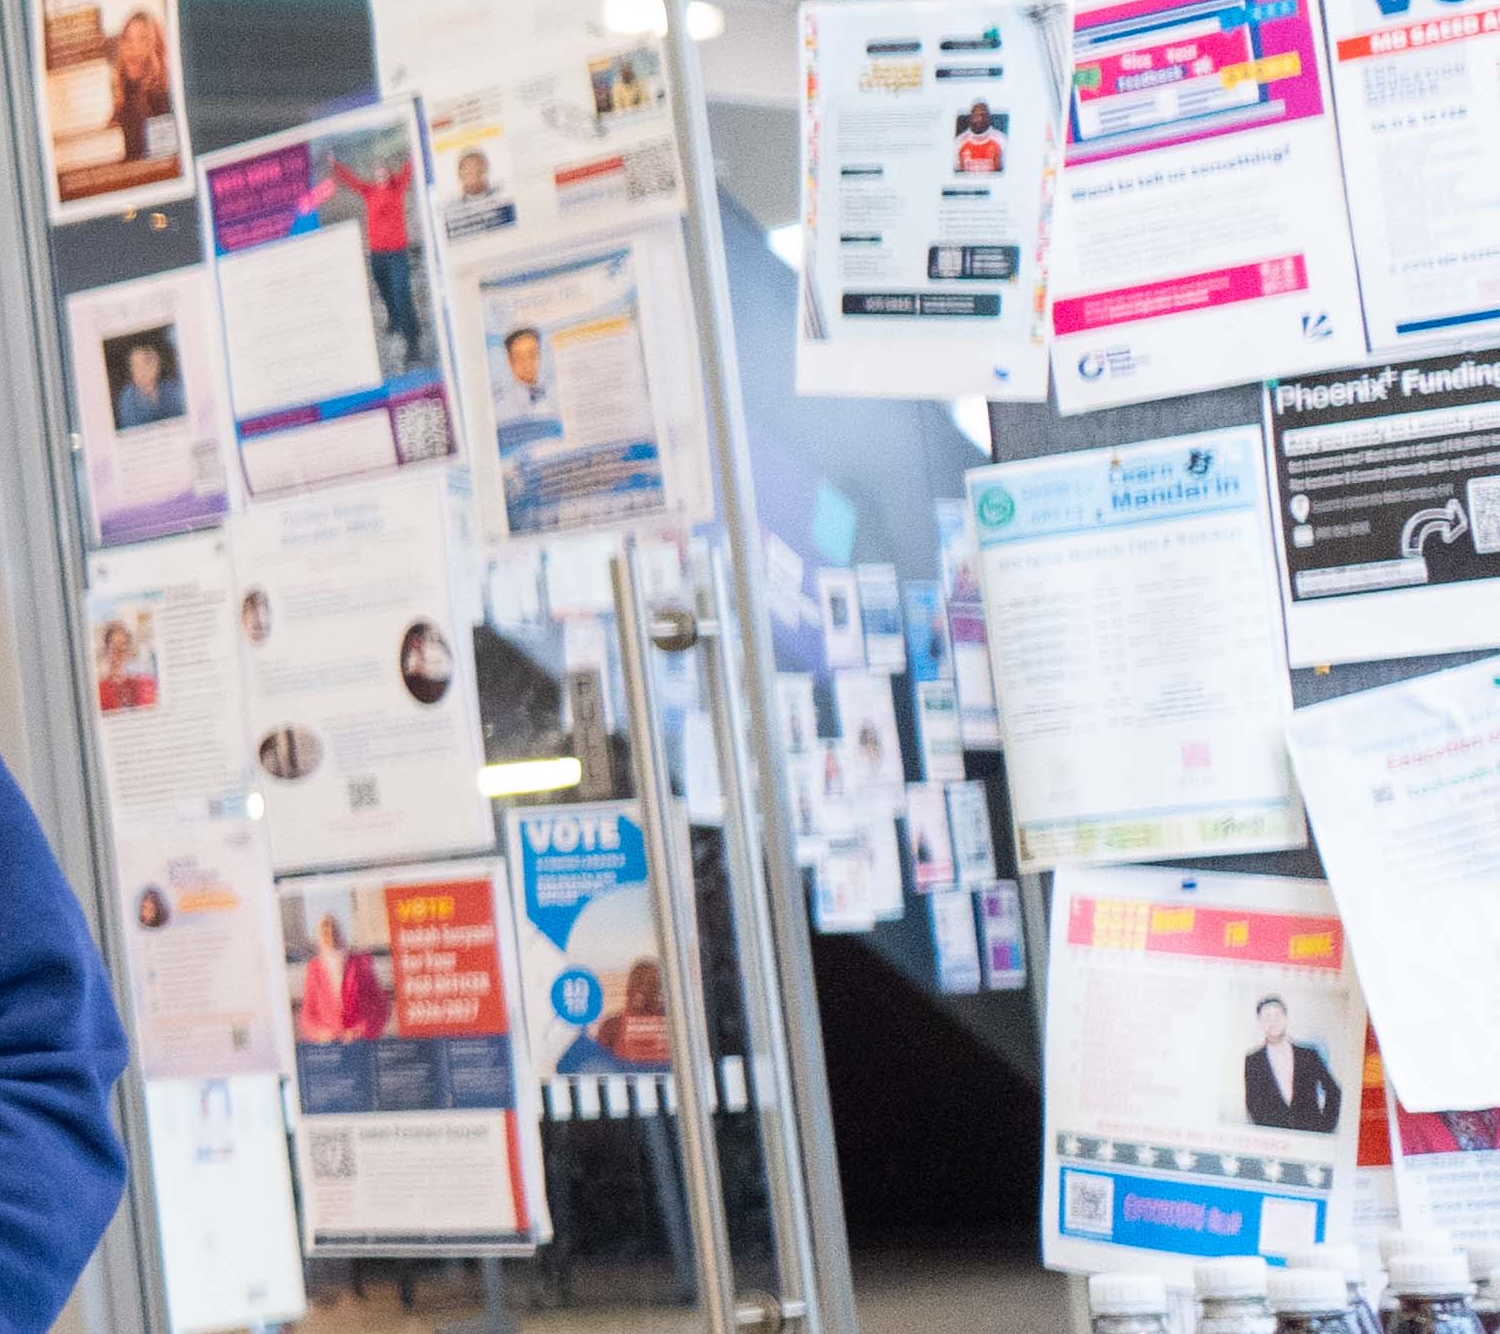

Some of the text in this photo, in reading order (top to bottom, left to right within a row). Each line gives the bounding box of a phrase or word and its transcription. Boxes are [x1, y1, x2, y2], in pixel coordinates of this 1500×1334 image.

[1111, 477, 1240, 510] Mandarin
[525, 817, 621, 855] VOTE
[397, 895, 456, 924] VOTE
